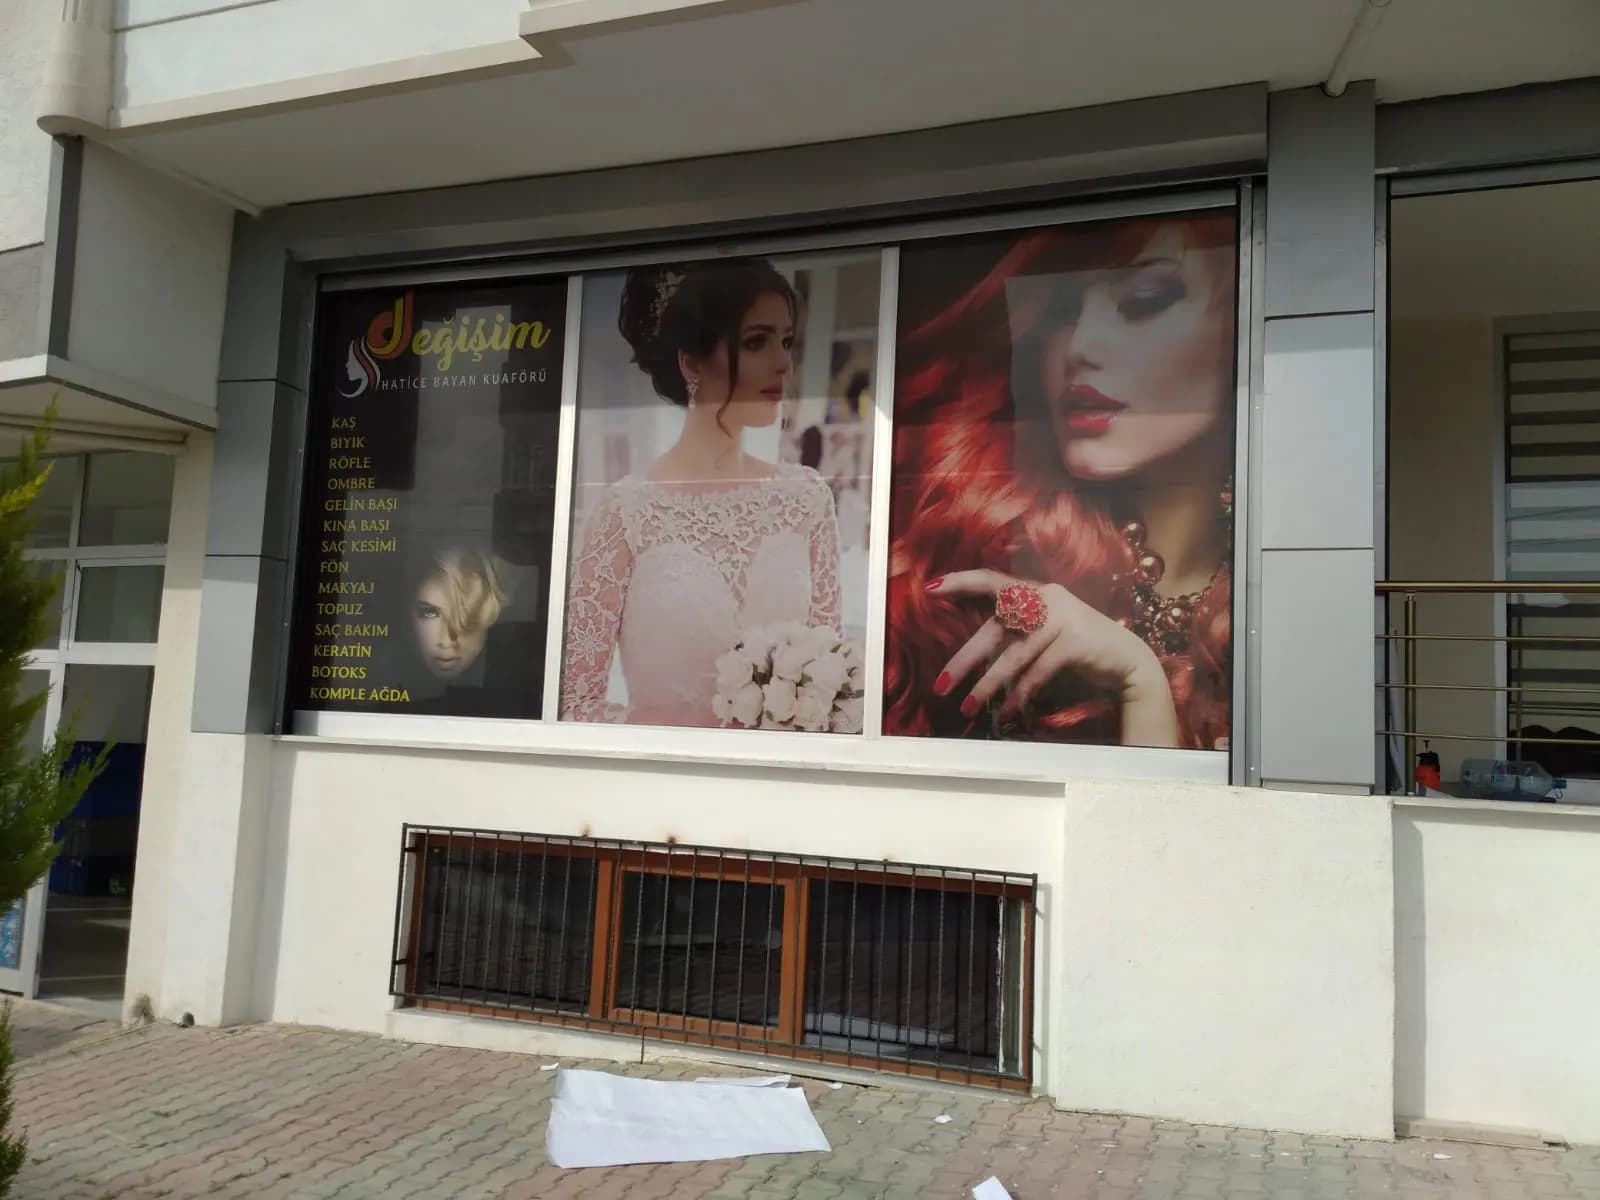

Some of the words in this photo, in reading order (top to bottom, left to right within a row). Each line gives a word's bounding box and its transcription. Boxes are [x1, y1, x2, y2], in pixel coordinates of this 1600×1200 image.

[381, 378, 427, 391] HATİCE
[433, 375, 477, 388] BAYAN
[483, 368, 547, 385] KUAFÖRÜ
[331, 416, 356, 430] KAŞ
[330, 436, 366, 449] BIYIK
[329, 456, 371, 469] RÖFLE
[327, 478, 376, 490] OMBRE
[324, 496, 365, 511] GELİN
[368, 497, 398, 512] BAŞI
[323, 520, 357, 532] KINA
[360, 519, 390, 533] BAŞI
[321, 541, 348, 555] SAÇ
[351, 537, 397, 552] KESİMİ
[320, 560, 349, 573] FÖN
[318, 582, 375, 594] MAKYAJ
[316, 603, 364, 615] TOPUZ
[314, 624, 341, 638] SAÇ
[344, 624, 389, 637] BAKIM
[313, 642, 372, 657] KERATİN
[311, 665, 367, 679] BOTOKS
[309, 687, 366, 700] KOMPLE
[369, 686, 411, 702] AĞDA
